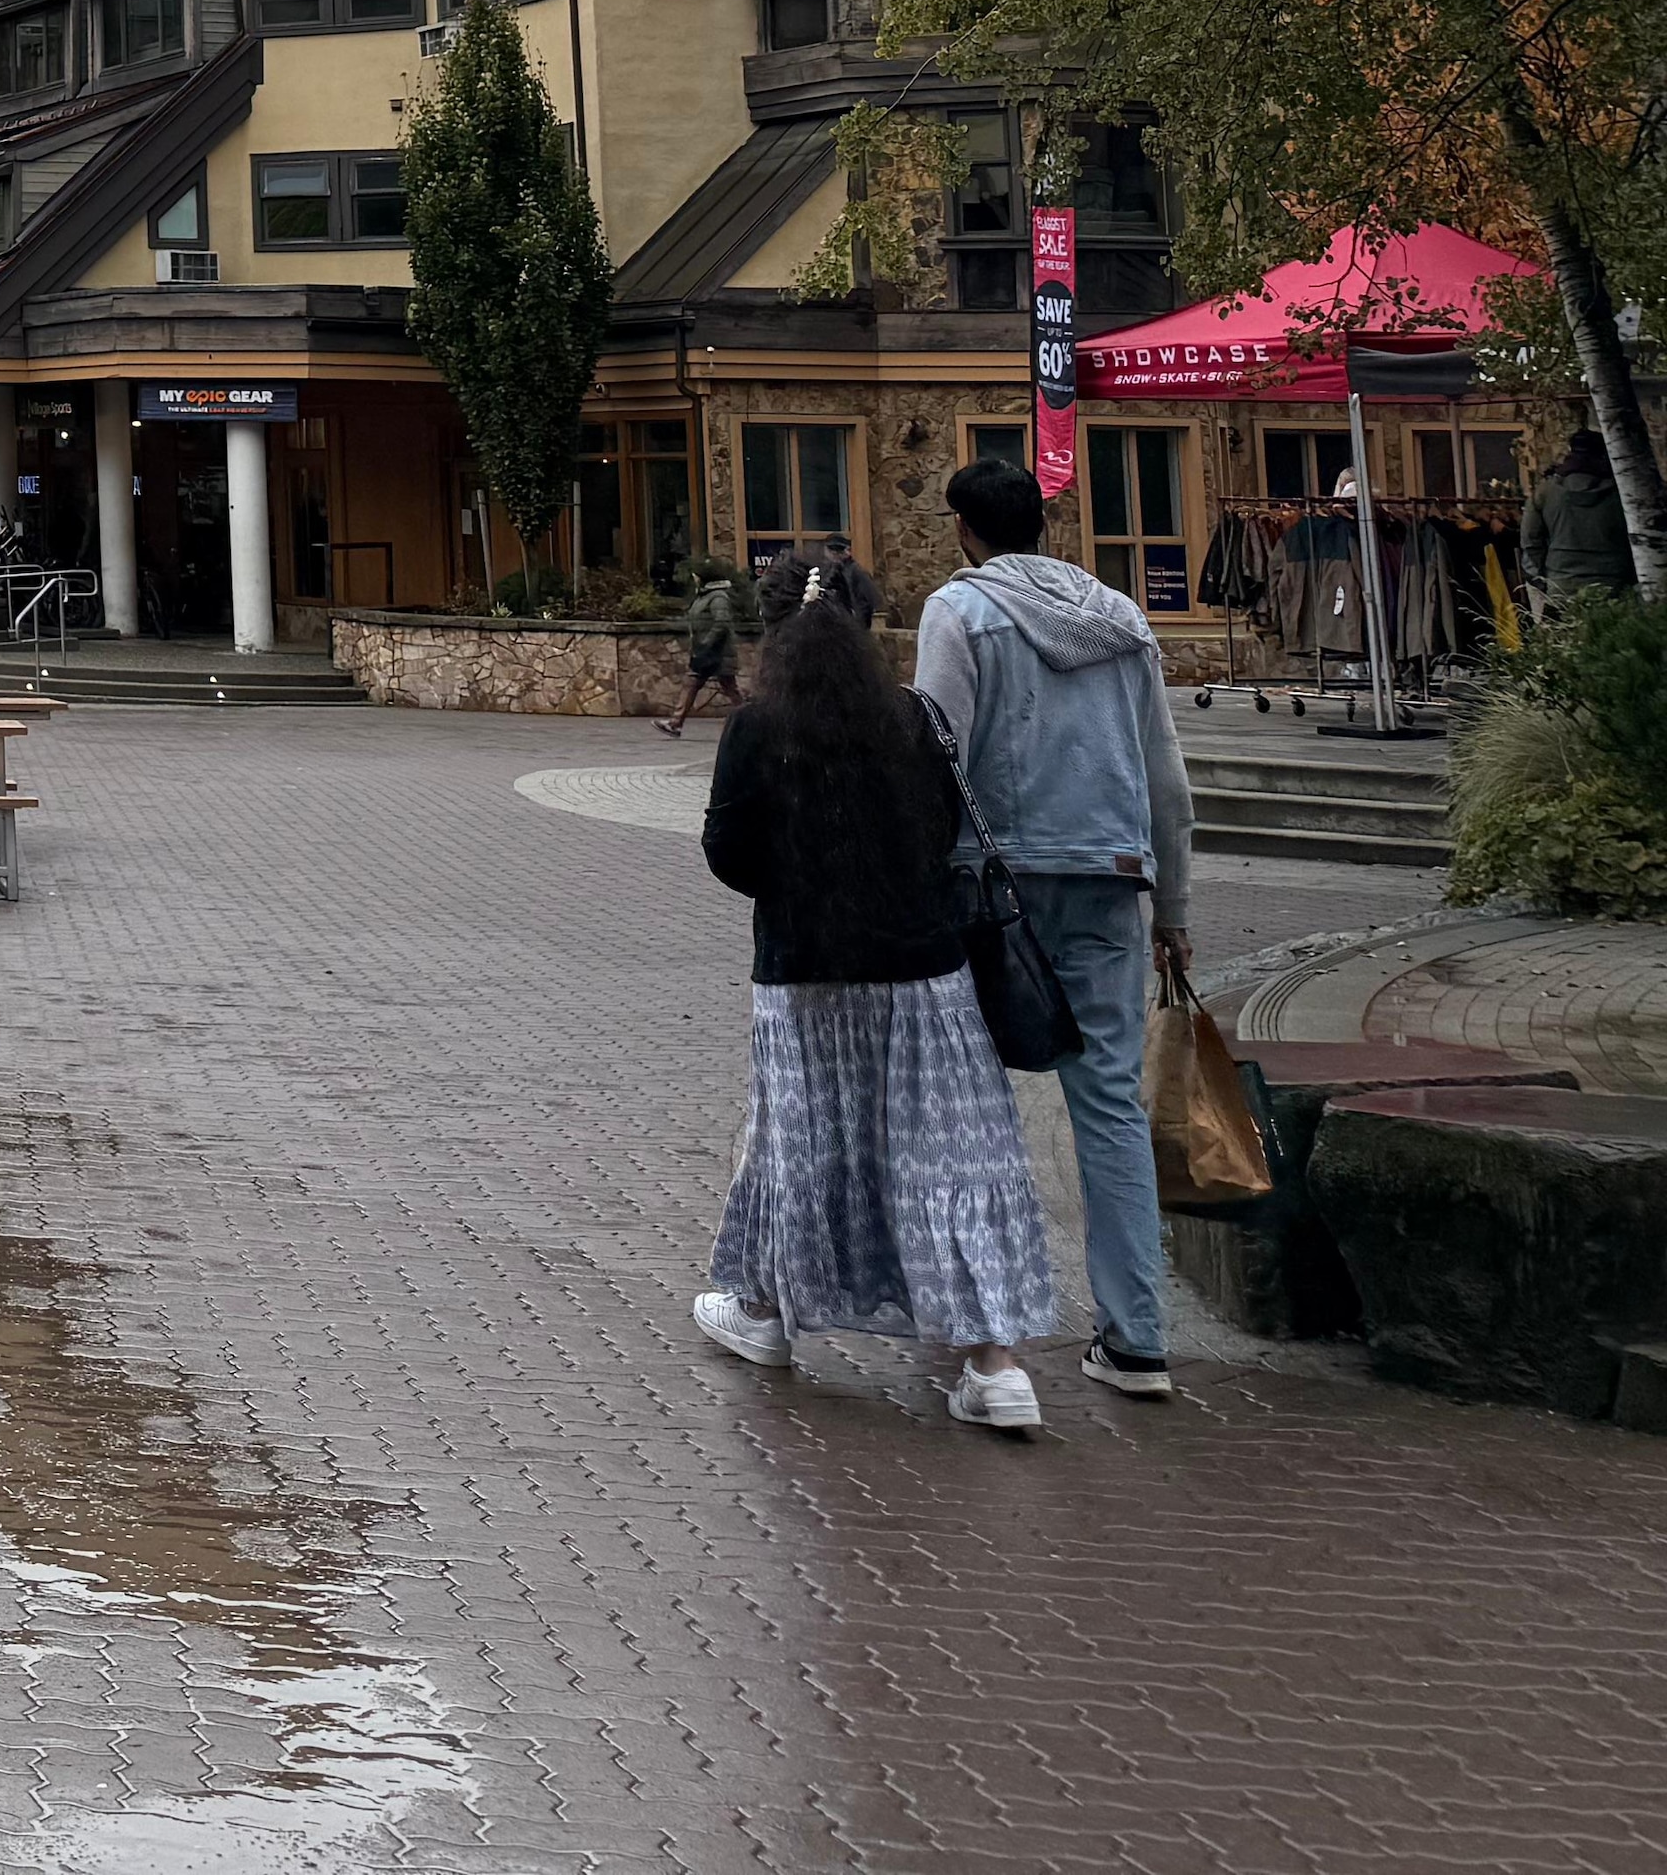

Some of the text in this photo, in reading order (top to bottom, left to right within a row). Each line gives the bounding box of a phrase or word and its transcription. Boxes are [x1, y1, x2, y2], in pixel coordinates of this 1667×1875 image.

[1038, 233, 1068, 256] SALE
[1036, 295, 1073, 324] SAVE
[1038, 340, 1073, 380] 60%
[1091, 343, 1270, 368] SHOWCASE
[1114, 374, 1153, 385] SNOW
[1159, 372, 1198, 384] SKATE
[159, 389, 274, 407] MY epic GEAR
